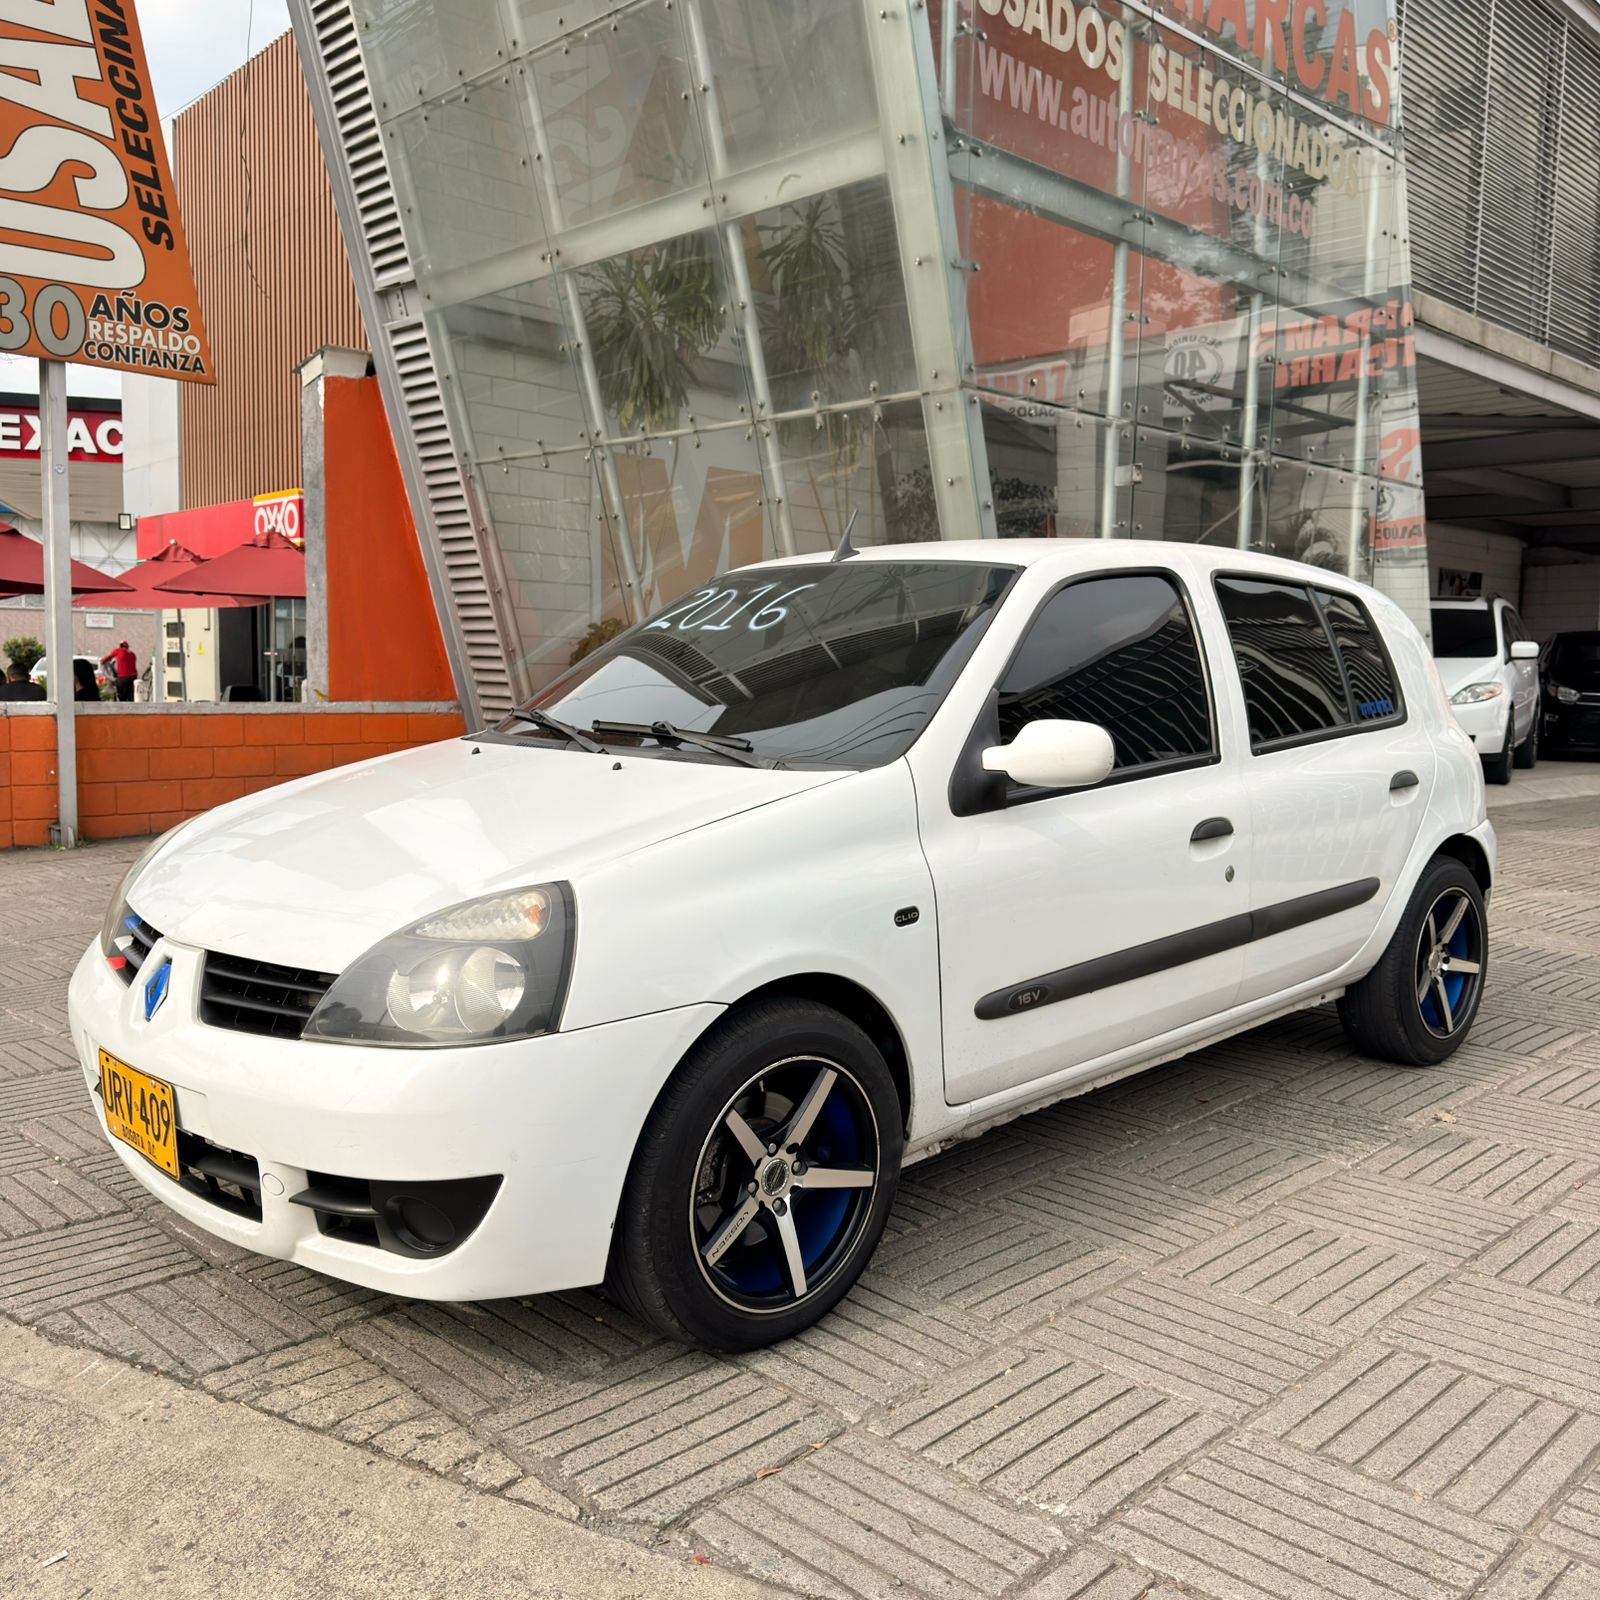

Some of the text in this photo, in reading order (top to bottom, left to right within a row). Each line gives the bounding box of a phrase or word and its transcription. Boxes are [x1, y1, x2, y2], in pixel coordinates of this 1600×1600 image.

[1149, 42, 1360, 198] SELECCIONADOS
[0, 0, 147, 290] USA
[0, 276, 192, 357] 30 AÑOS
[88, 320, 202, 355] RESPALDO
[82, 341, 207, 374] CONFIANZA
[254, 500, 299, 538] OXXO
[641, 581, 819, 631] 2016
[895, 911, 918, 923] CLIO
[1017, 989, 1041, 1006] 16V
[711, 1211, 749, 1258] VOSSEN
